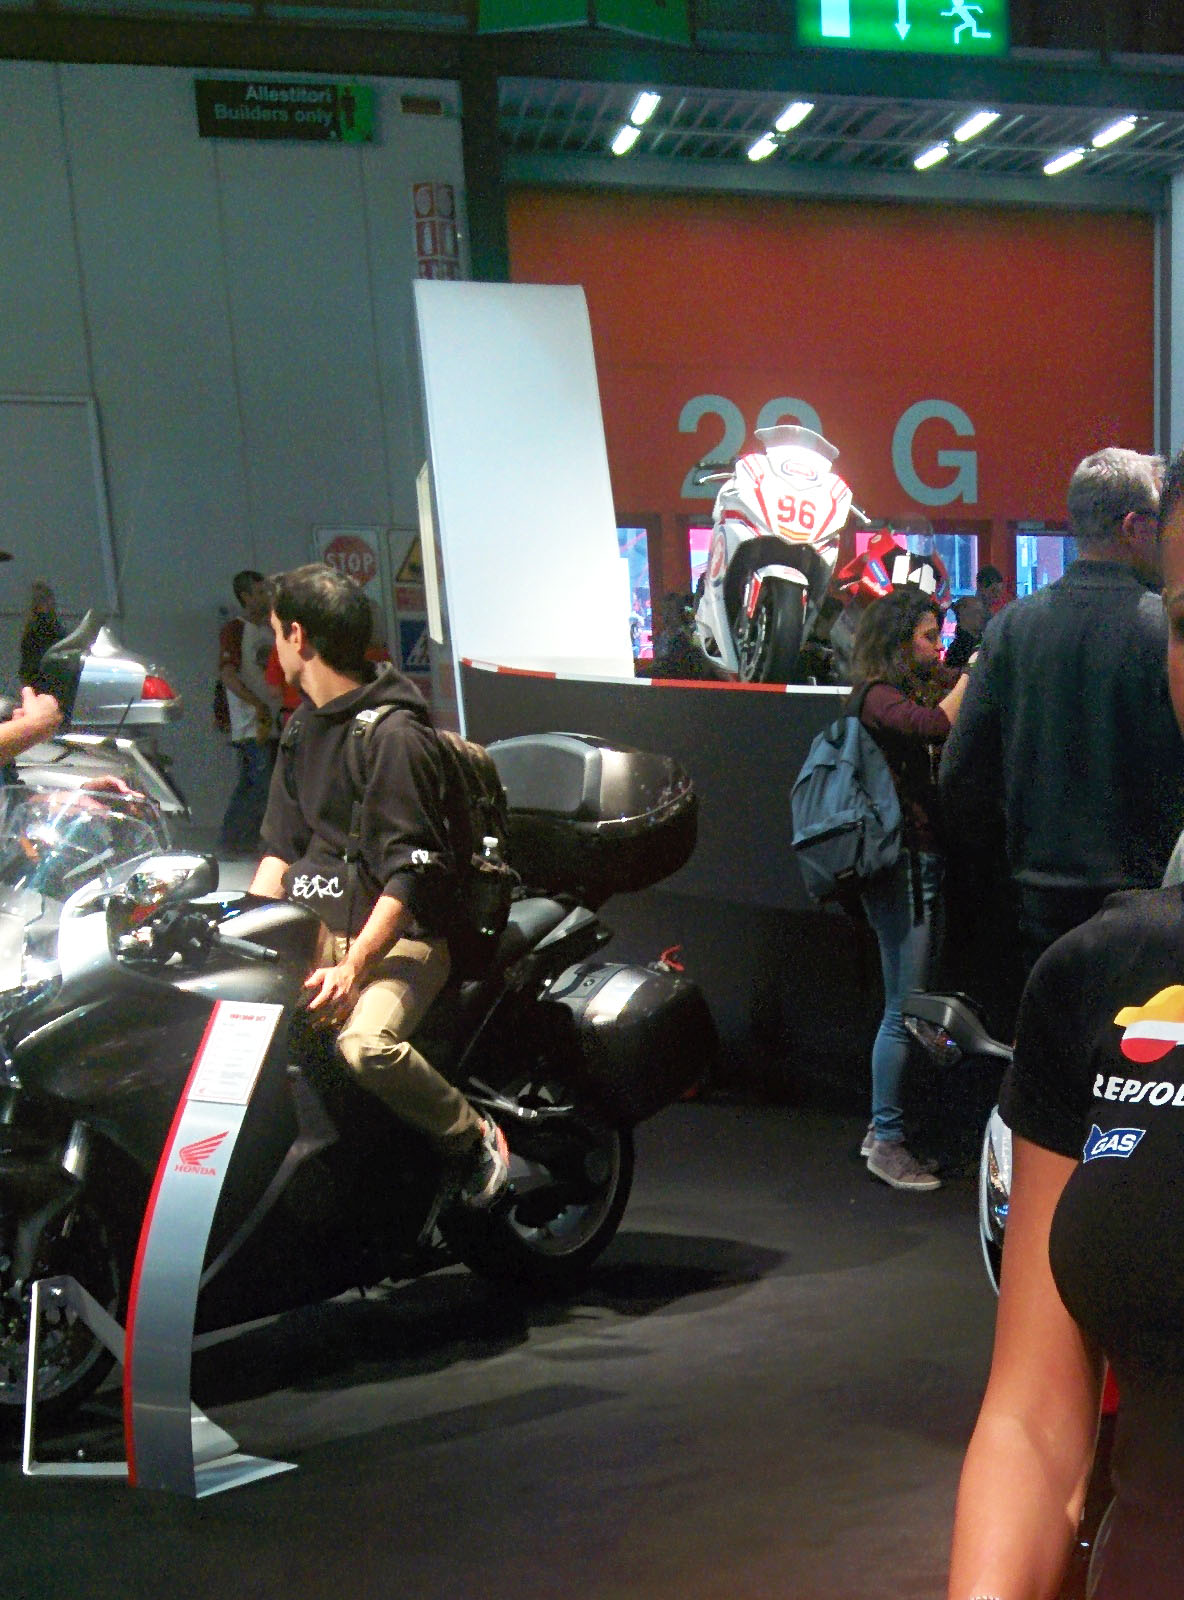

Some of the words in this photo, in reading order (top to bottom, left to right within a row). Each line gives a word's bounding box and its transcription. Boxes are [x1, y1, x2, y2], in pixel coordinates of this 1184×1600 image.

[214, 103, 289, 121] Builders
[295, 110, 333, 127] only
[892, 399, 978, 506] G
[777, 495, 816, 529] 96
[326, 552, 374, 574] STOP
[1091, 1133, 1138, 1155] GAS
[174, 1164, 217, 1177] HONDA
